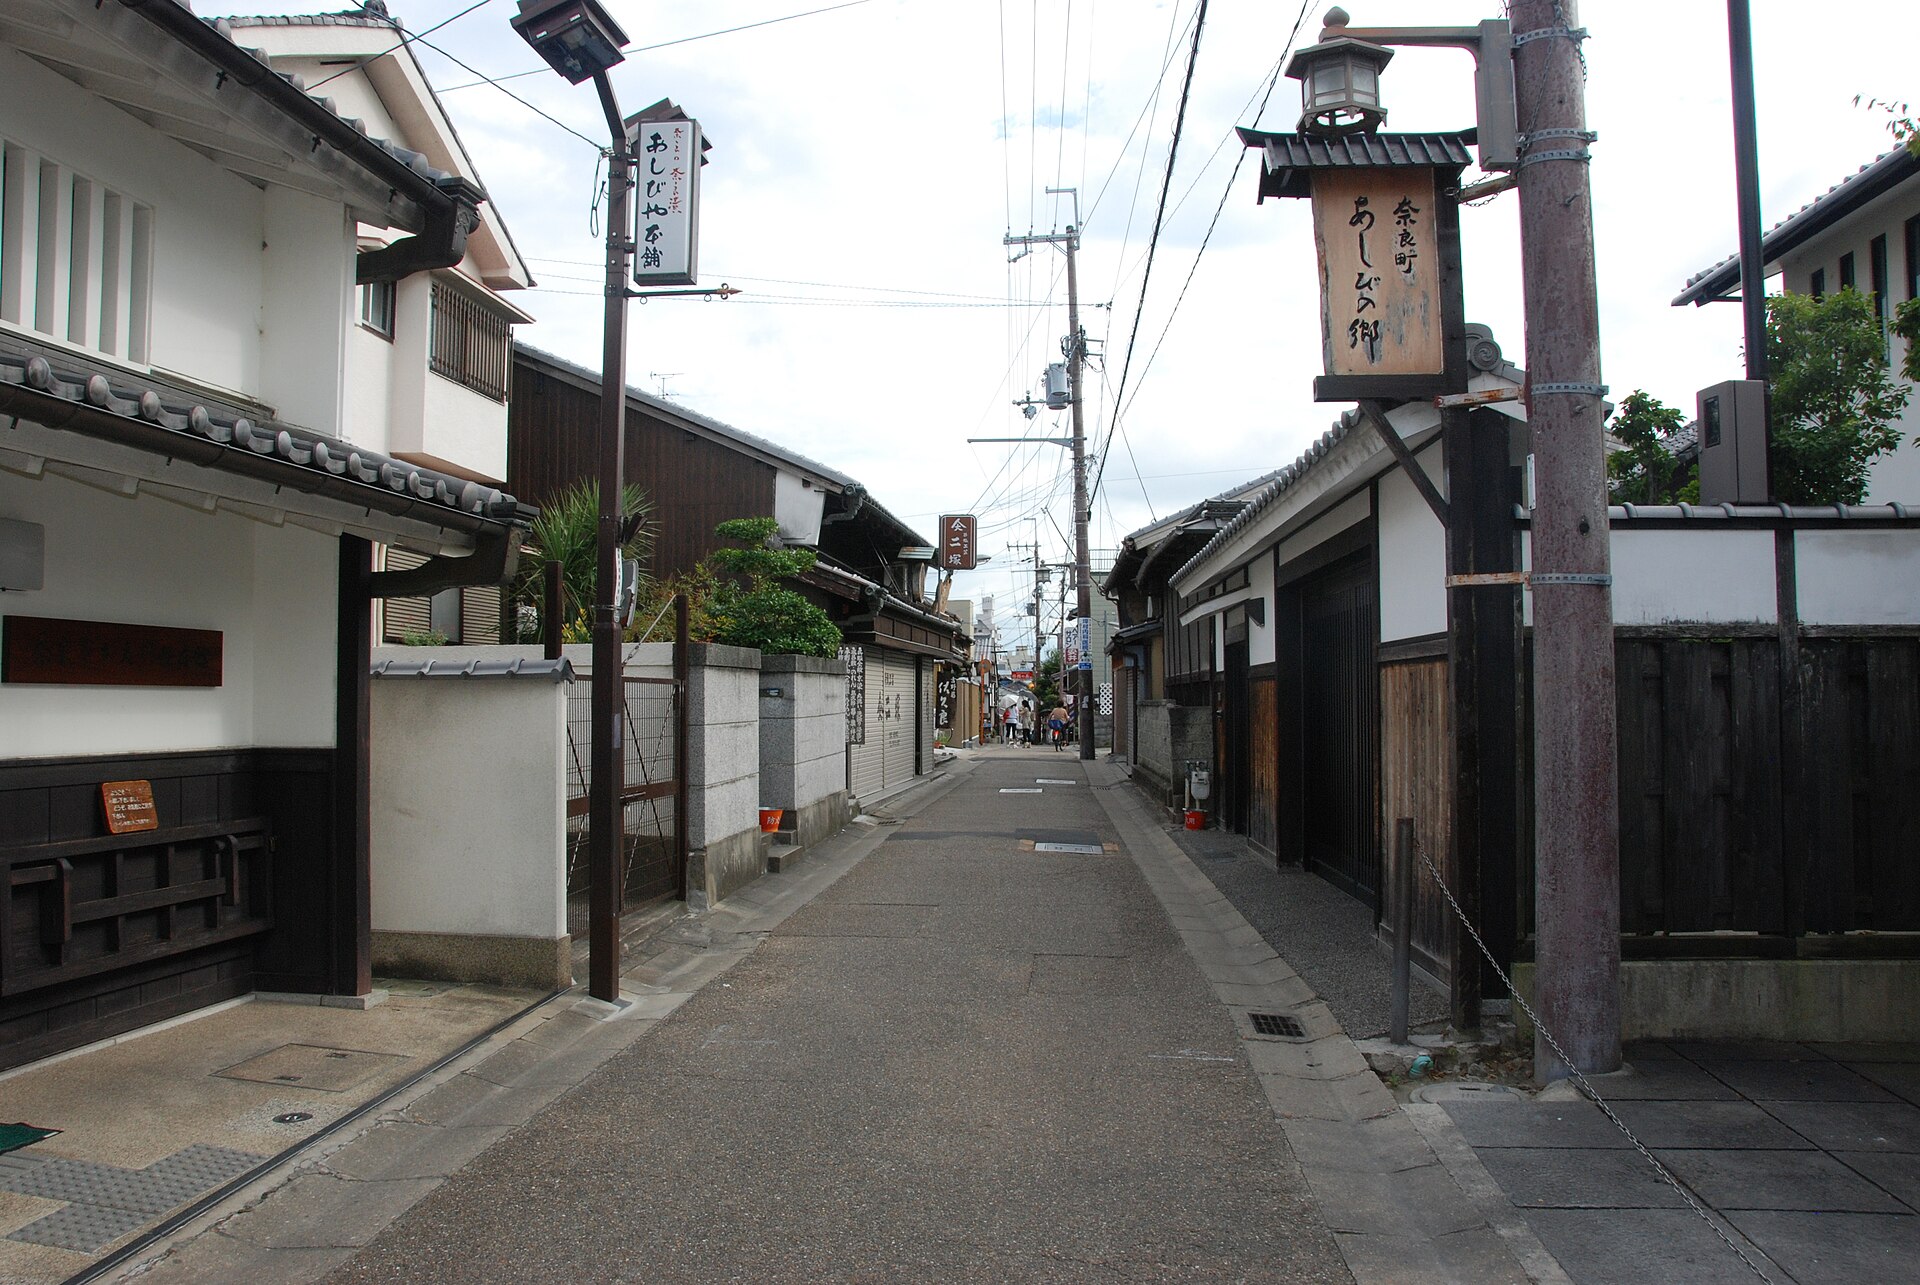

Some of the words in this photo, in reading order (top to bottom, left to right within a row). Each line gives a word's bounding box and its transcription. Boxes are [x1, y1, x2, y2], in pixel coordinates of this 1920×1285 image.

[641, 132, 669, 269] あしびや本舗
[1392, 195, 1421, 274] 奈良町
[1348, 195, 1381, 364] あしびの郷
